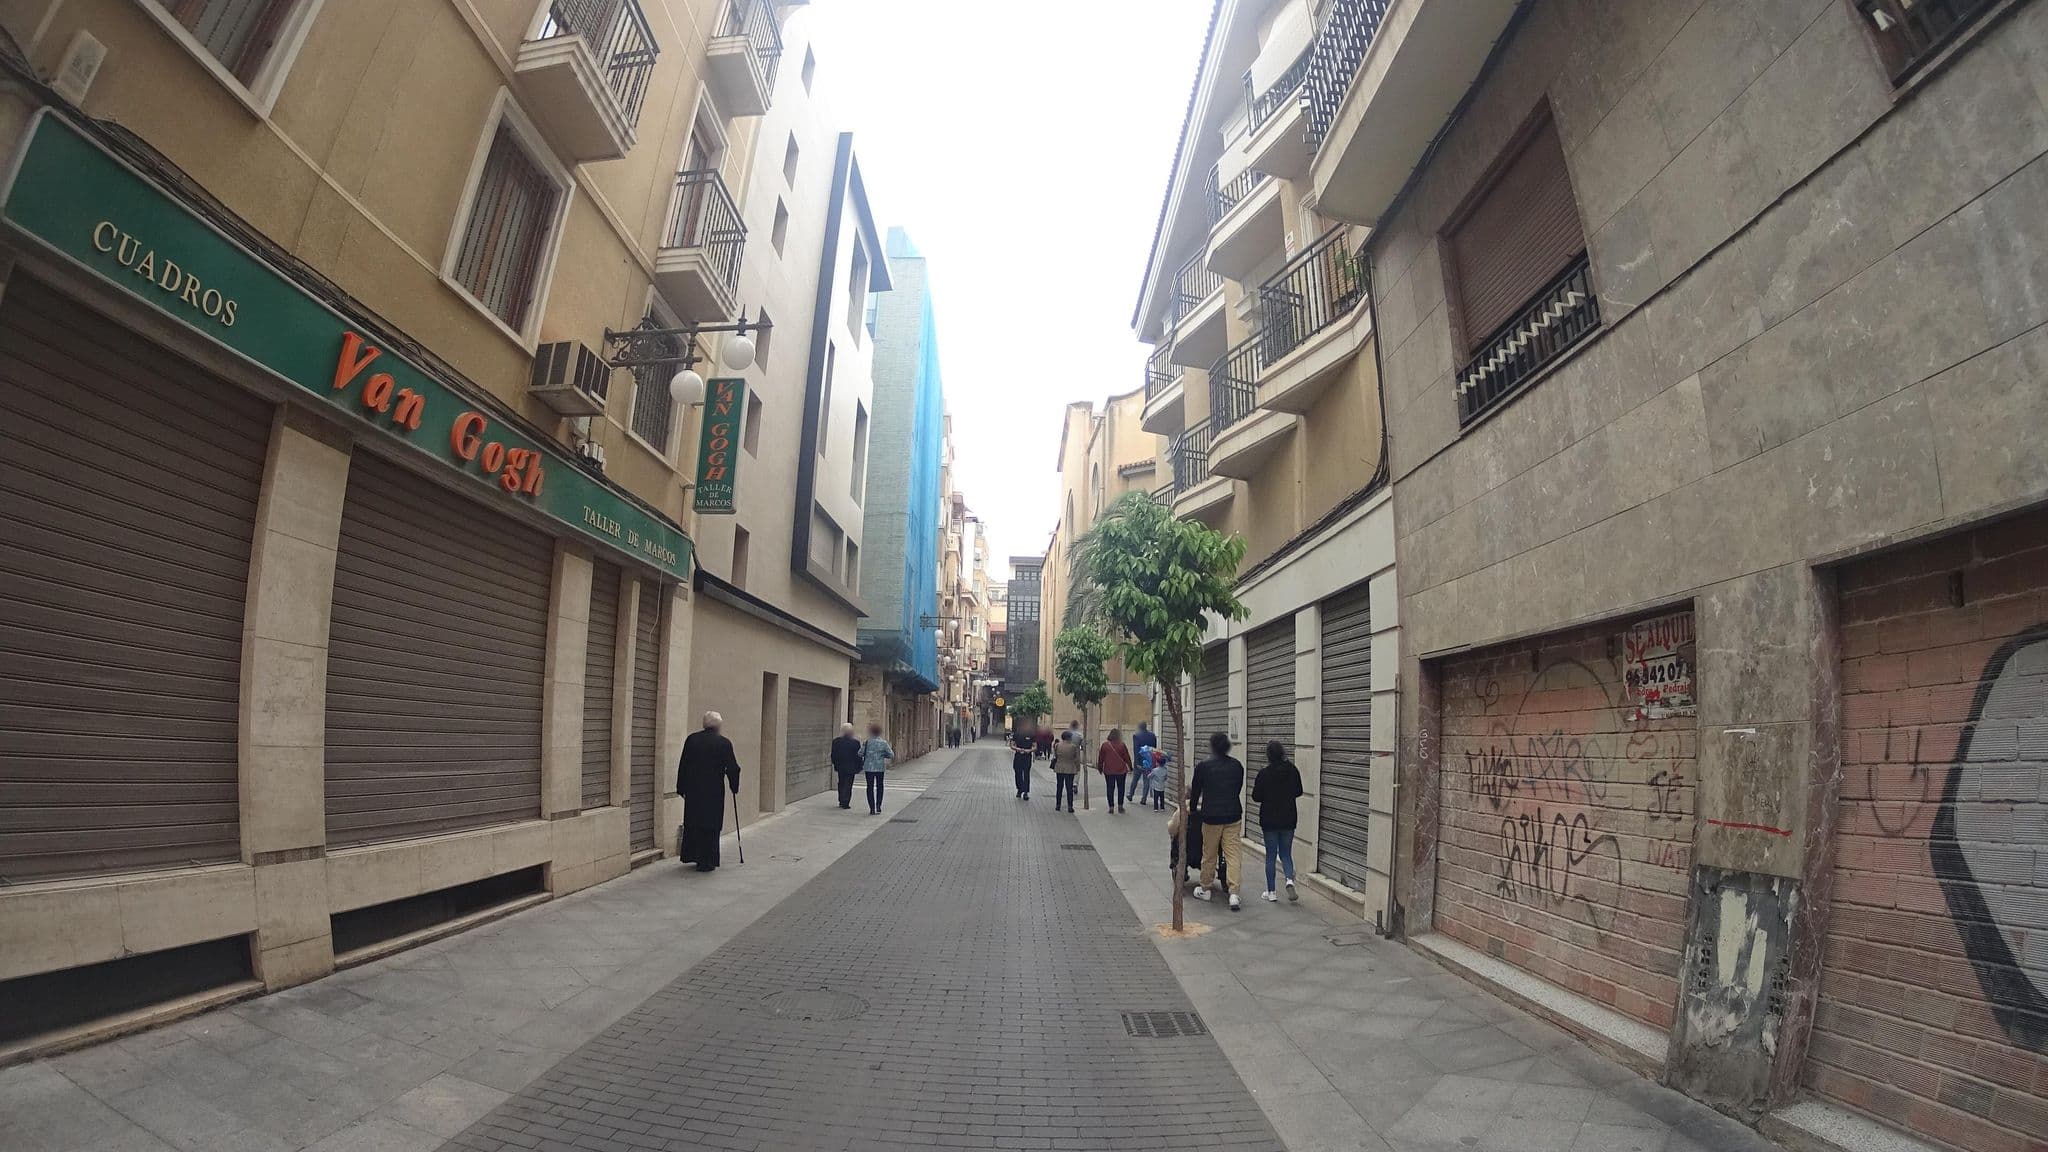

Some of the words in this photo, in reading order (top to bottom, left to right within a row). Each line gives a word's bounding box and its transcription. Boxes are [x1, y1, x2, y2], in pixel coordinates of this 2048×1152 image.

[93, 221, 238, 327] CUADROS
[333, 331, 426, 431] Van
[450, 411, 545, 496] Gogh
[712, 382, 735, 416] VAN
[704, 423, 730, 481] GOGH
[698, 484, 733, 494] TALLER
[583, 505, 621, 539] TALLER
[627, 529, 640, 548] DE
[644, 539, 677, 566] MARCOS
